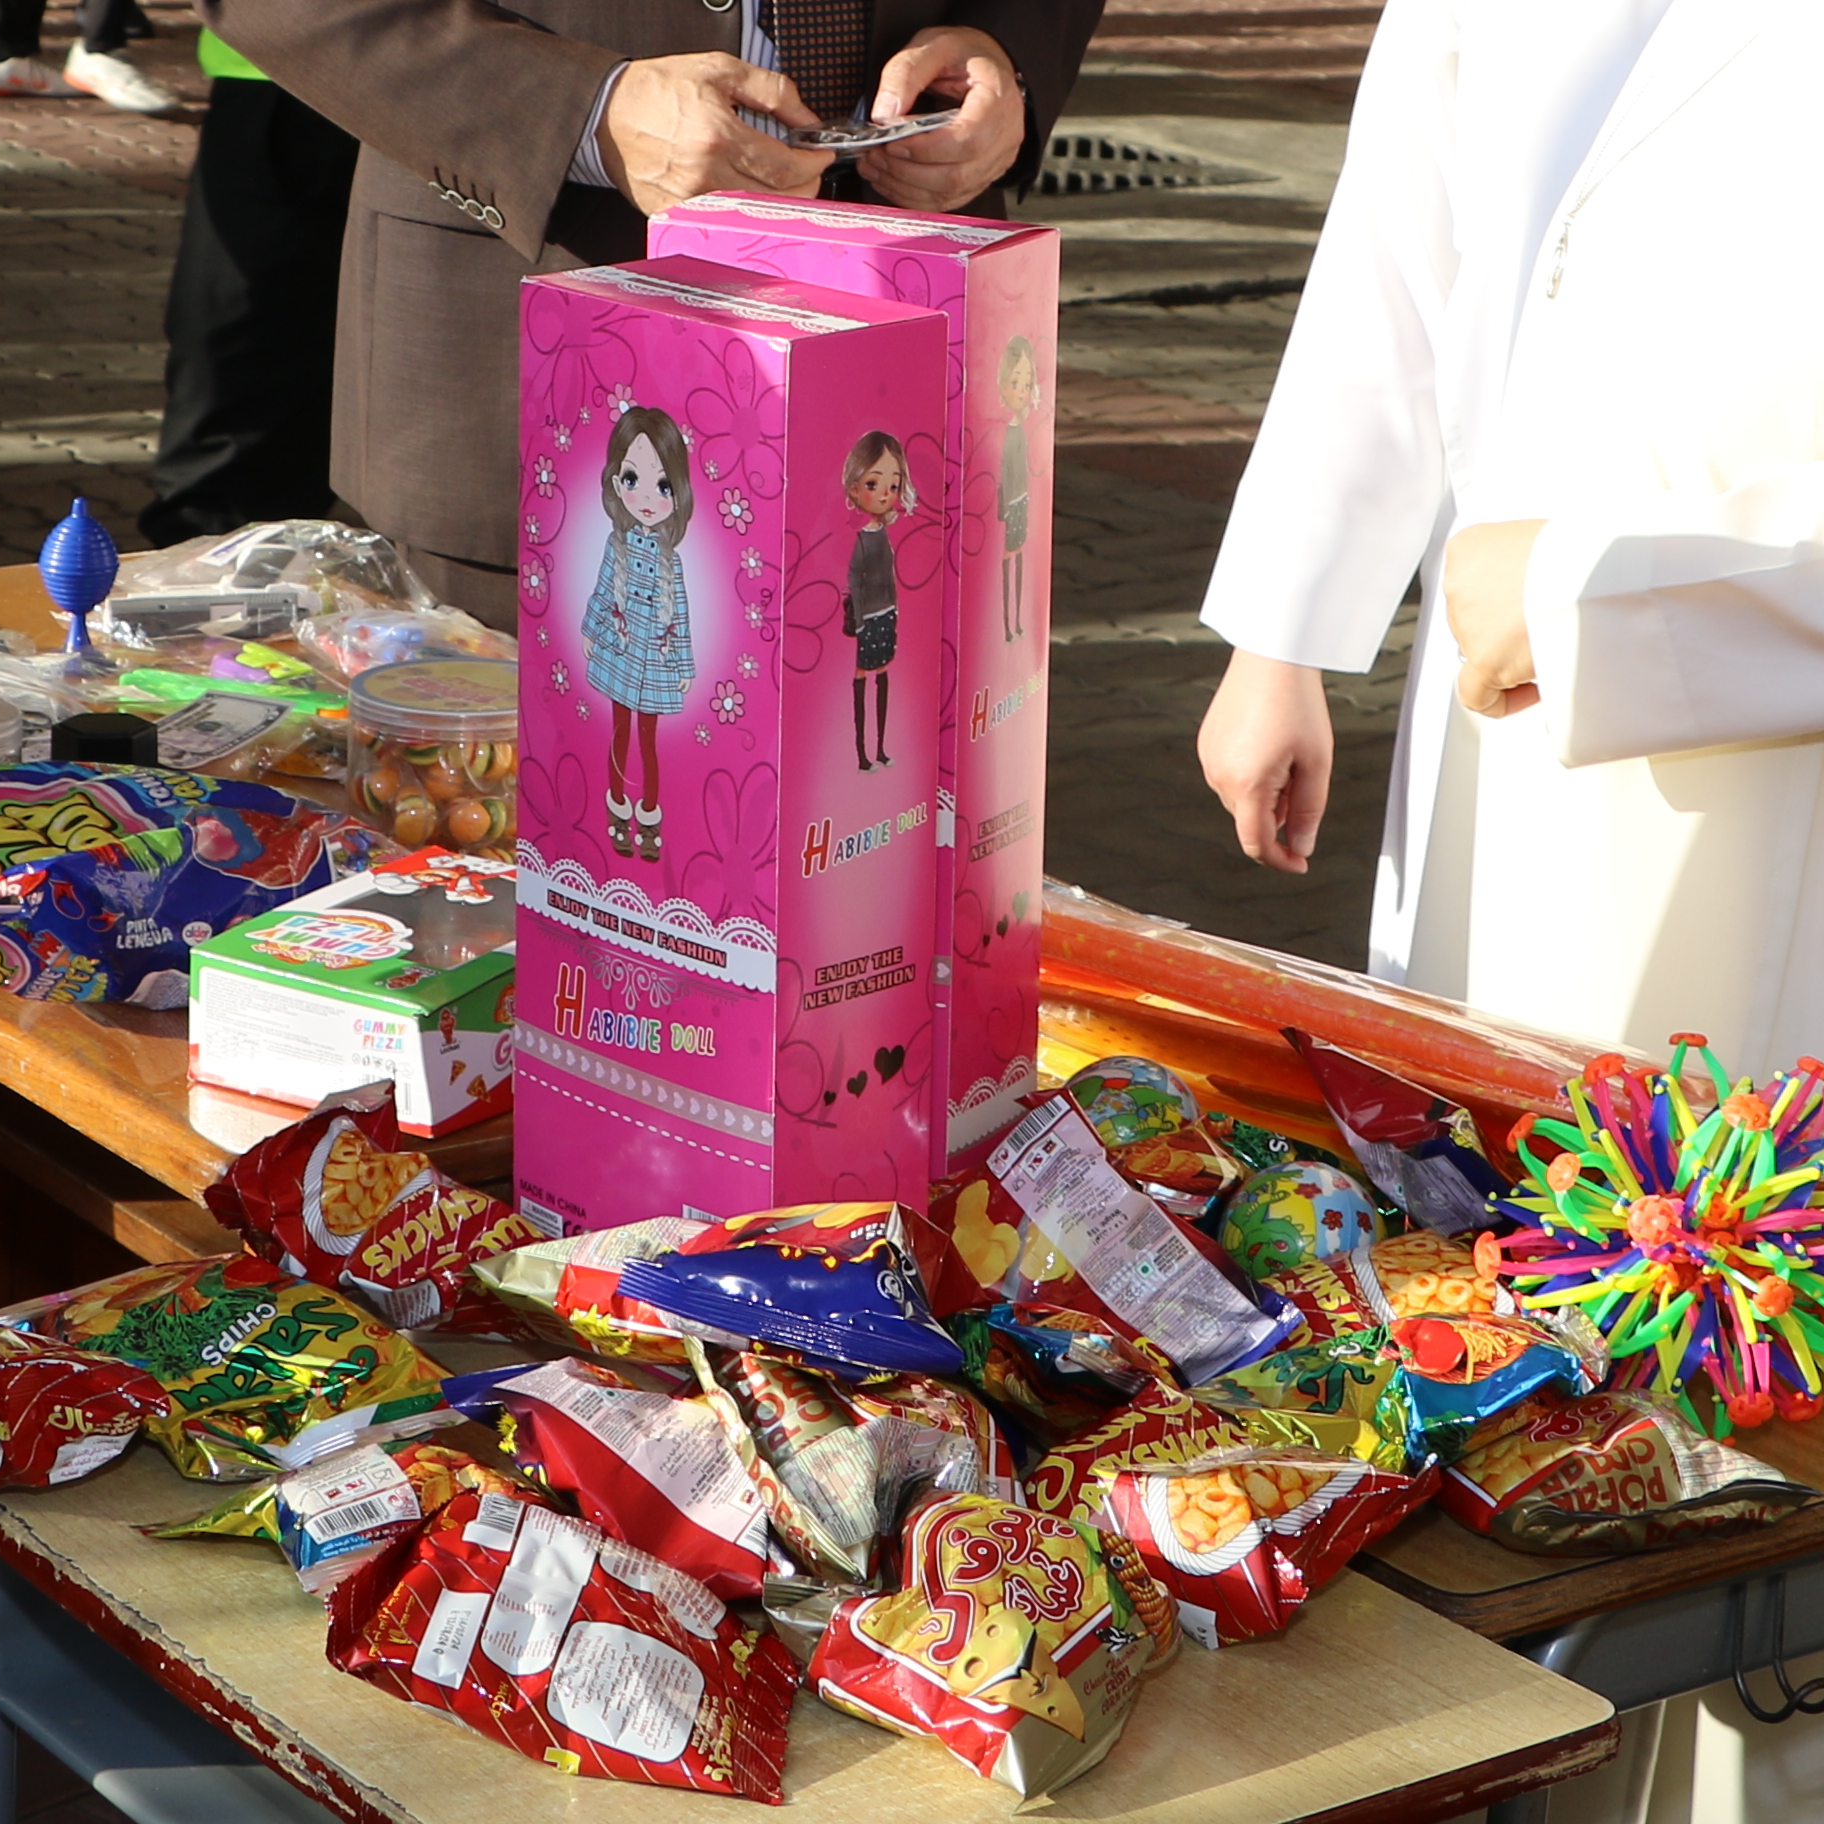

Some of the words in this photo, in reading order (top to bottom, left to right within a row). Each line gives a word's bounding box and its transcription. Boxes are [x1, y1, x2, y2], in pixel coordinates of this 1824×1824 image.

[802, 817, 891, 878] HABIBIE
[896, 802, 928, 835] DOLL
[259, 930, 401, 958] GUMMY
[286, 916, 395, 945] PIZZA
[547, 889, 589, 920] ENJOY
[592, 908, 619, 931] THE
[621, 918, 655, 943] NEW
[657, 933, 728, 969] FASHION
[803, 984, 843, 1012] NEW
[845, 964, 916, 1002] FASHION
[815, 954, 870, 987] ENJOY
[872, 946, 903, 972] THE
[353, 1018, 407, 1035] GUMMY
[554, 962, 662, 1054] HABIBIE
[671, 1022, 716, 1057] DOLL
[362, 1034, 404, 1051] PIZZA
[520, 1178, 544, 1200] MADE
[545, 1190, 556, 1205] IN
[557, 1197, 588, 1220] CHINA
[360, 1187, 488, 1278] SNACKS
[201, 1302, 278, 1367] CHIPS
